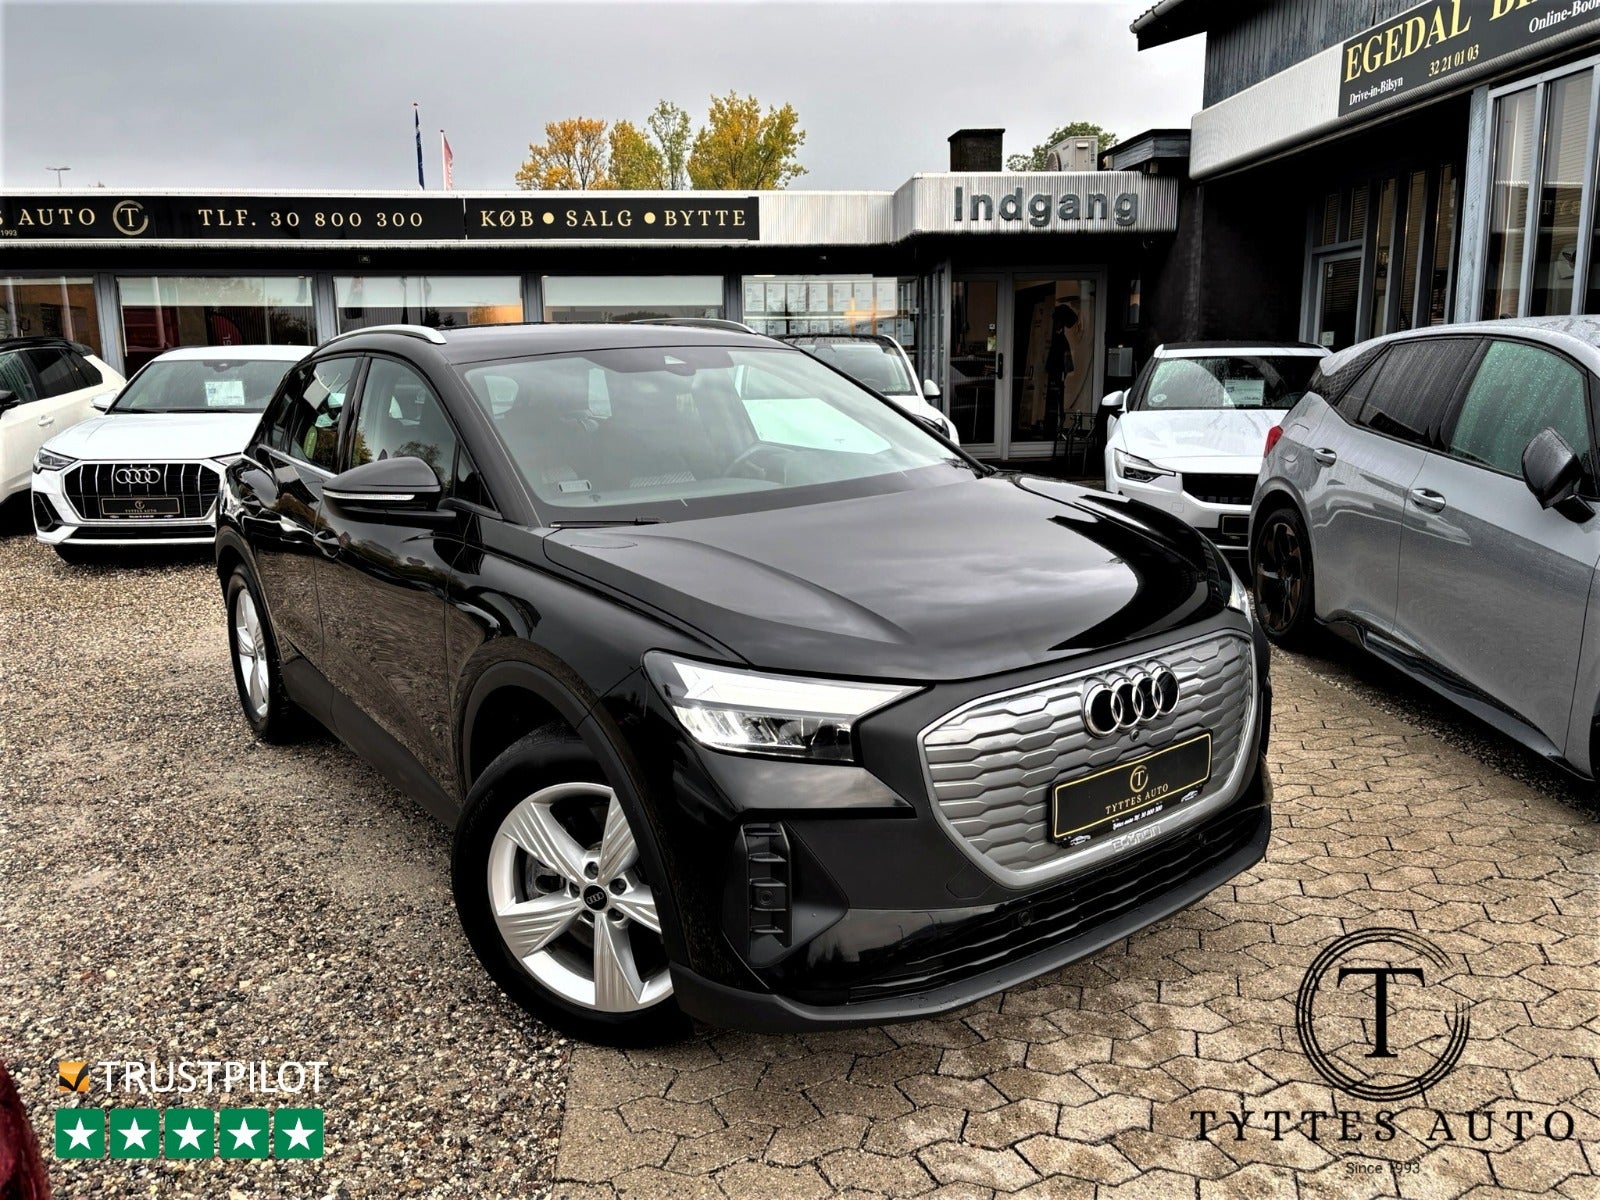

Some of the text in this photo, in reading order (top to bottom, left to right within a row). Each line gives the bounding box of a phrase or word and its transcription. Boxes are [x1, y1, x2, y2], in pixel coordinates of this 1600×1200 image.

[1344, 0, 1472, 83] EGEDAL
[1428, 44, 1480, 77] 32 21 01 03
[1349, 76, 1404, 106] Drive-in-Bilsyn
[18, 208, 96, 226] AUTO
[198, 209, 423, 227] TLF. 30 800 300
[480, 209, 747, 227] KØB SALG BYTTE
[954, 186, 1139, 227] Indgang
[1105, 783, 1169, 815] TYTTES AUTO
